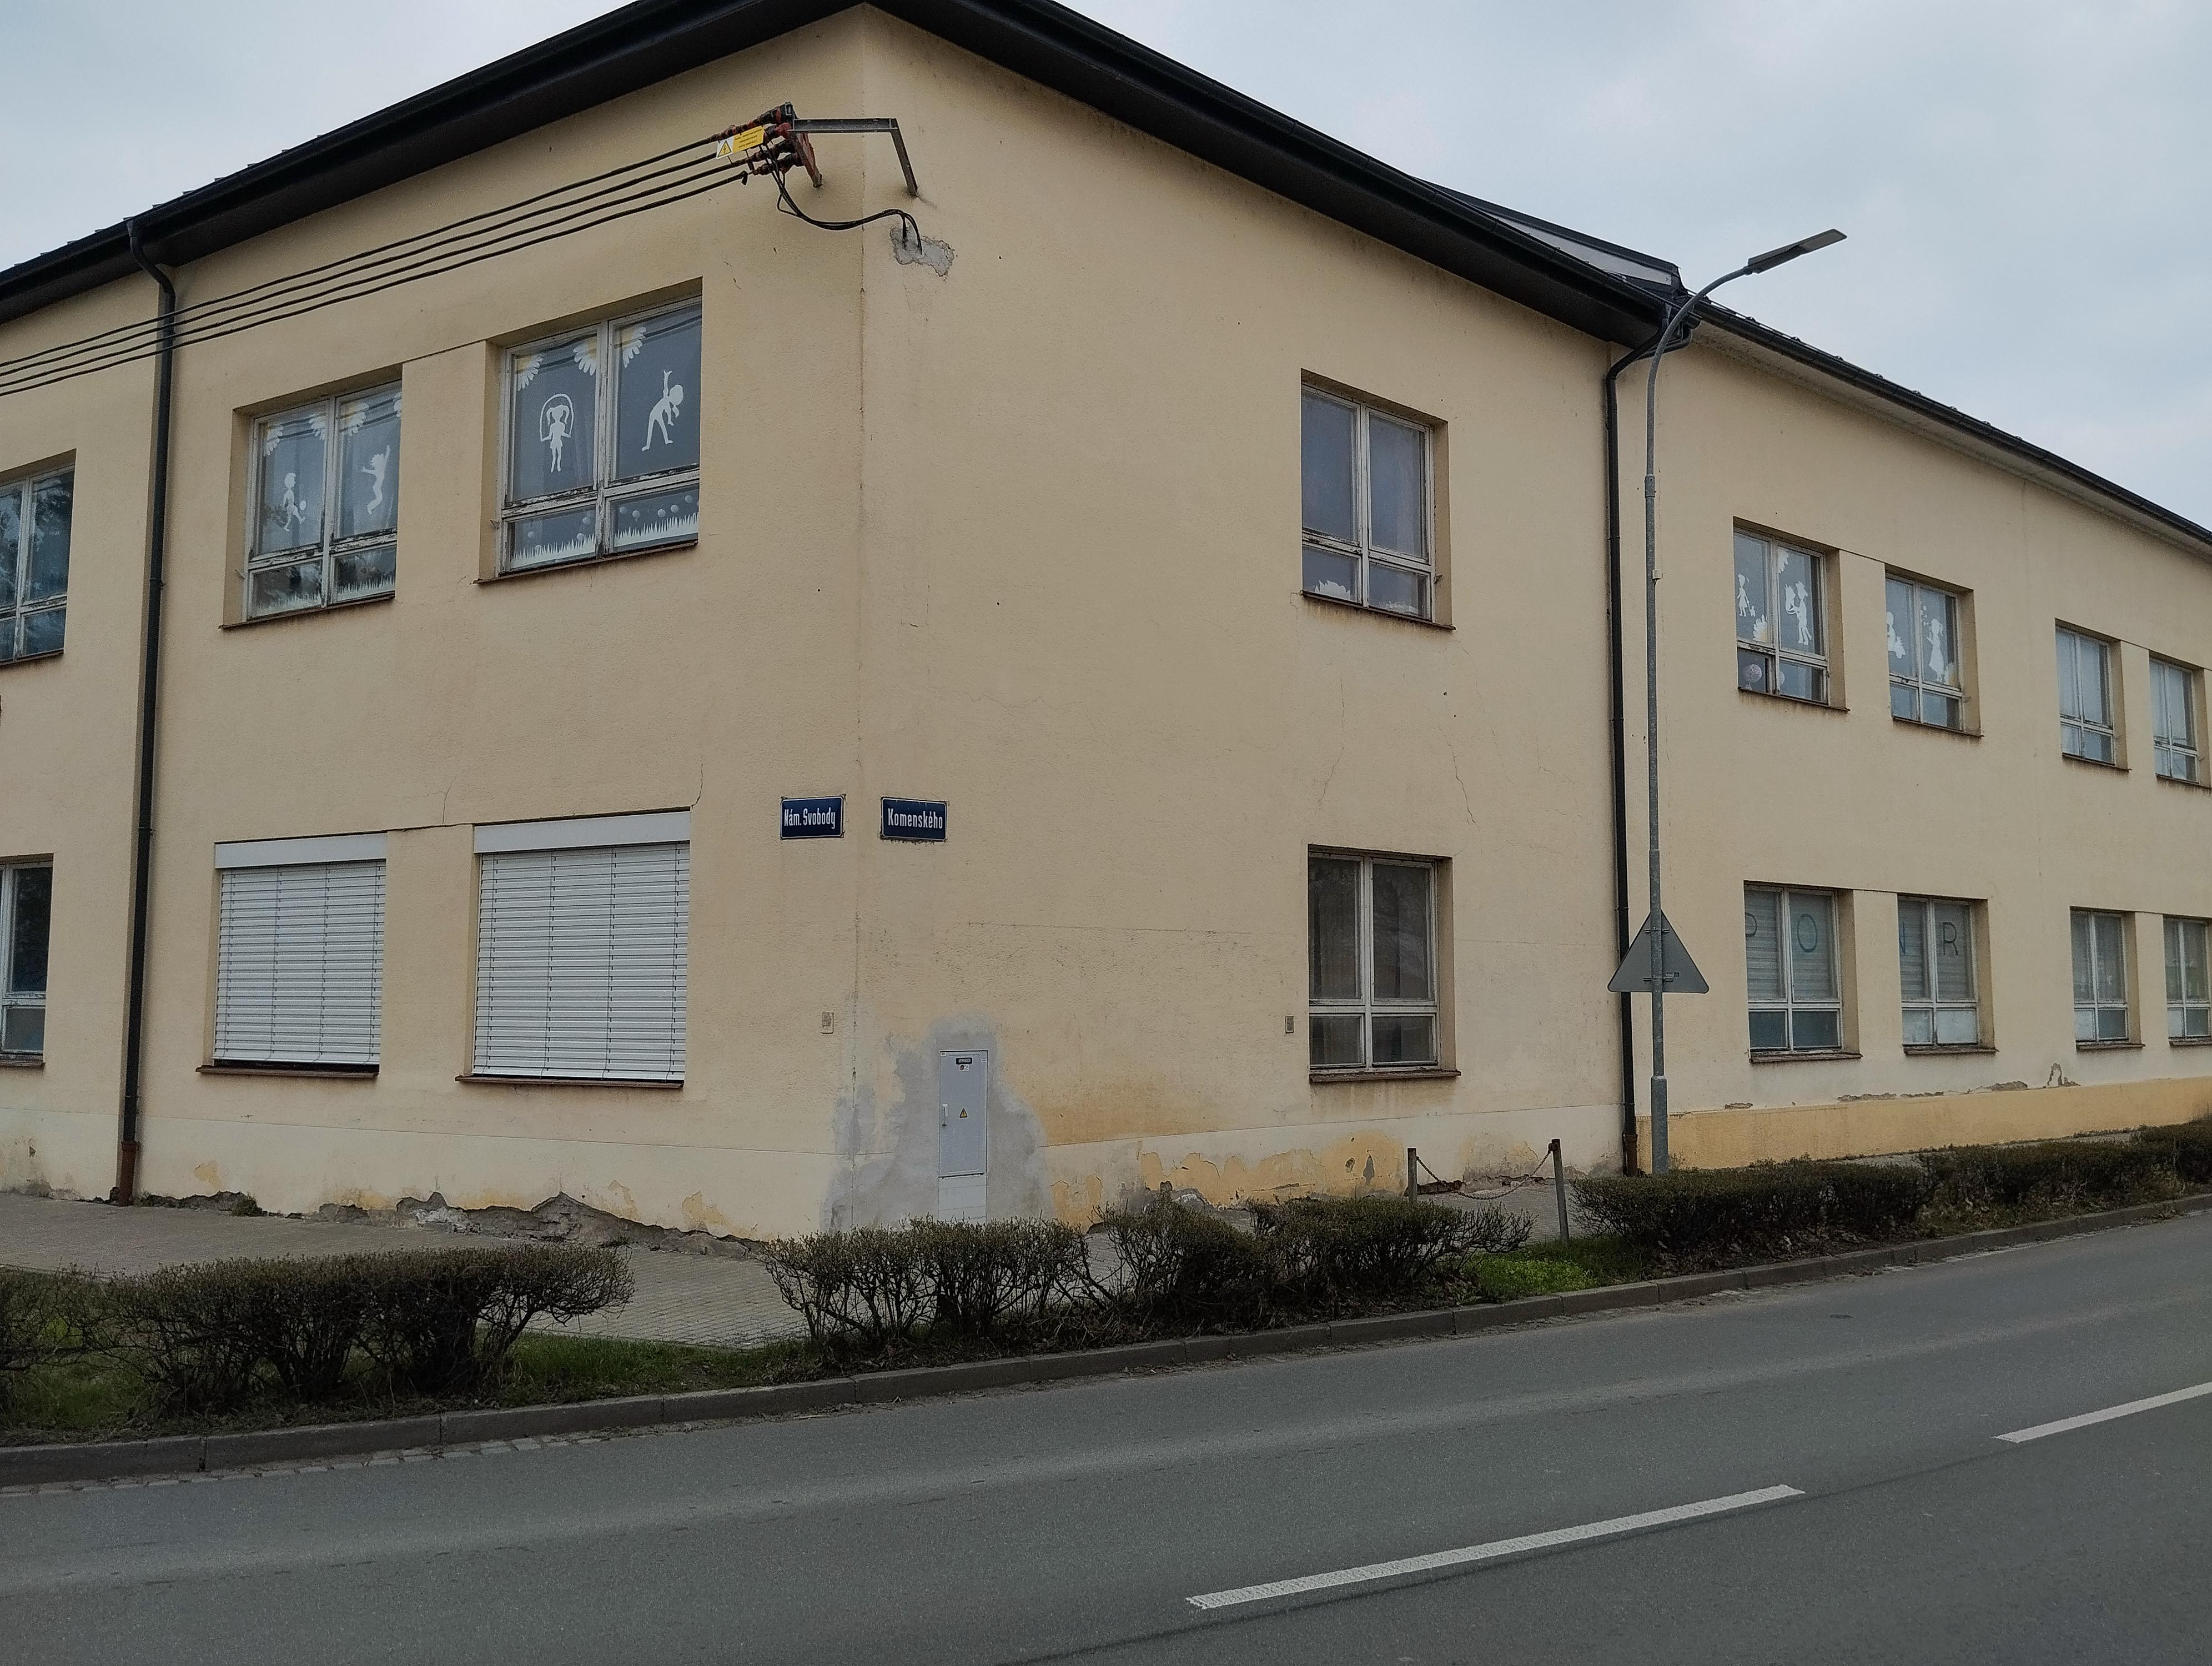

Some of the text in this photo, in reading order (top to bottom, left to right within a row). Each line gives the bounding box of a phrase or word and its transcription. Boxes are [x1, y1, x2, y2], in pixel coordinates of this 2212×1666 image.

[784, 807, 836, 829] Nám. Svobody
[888, 808, 943, 829] Komenského
